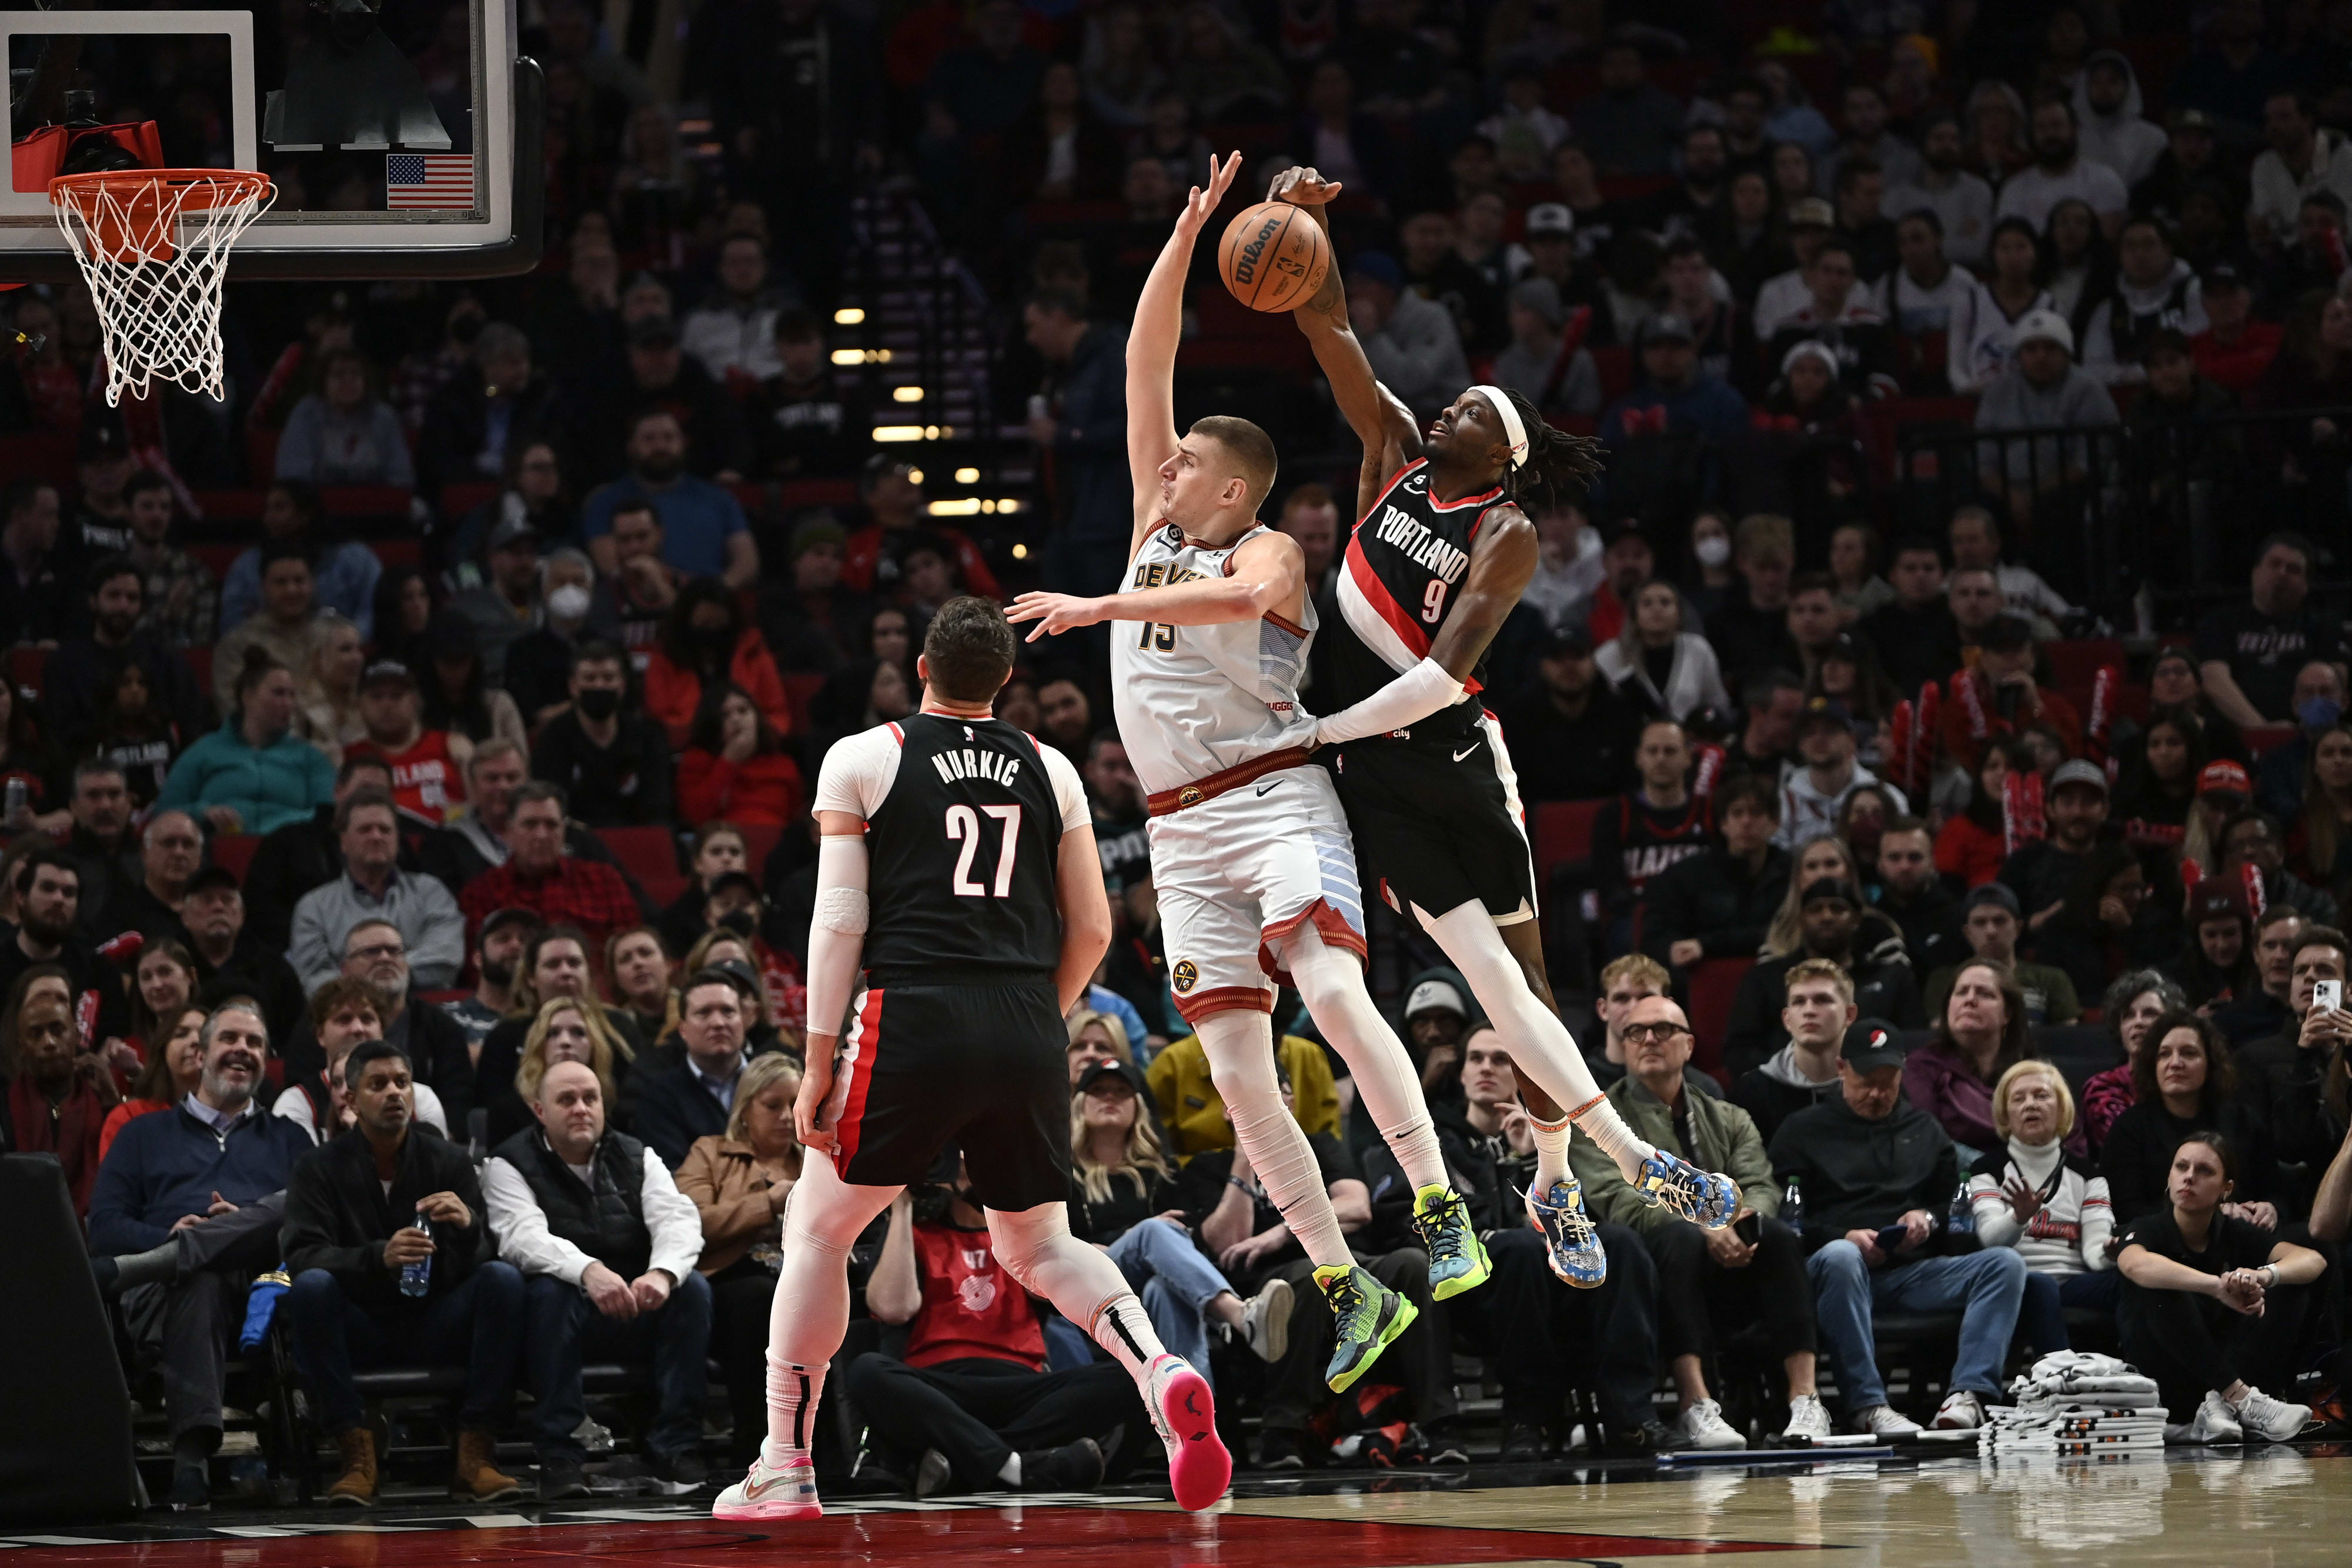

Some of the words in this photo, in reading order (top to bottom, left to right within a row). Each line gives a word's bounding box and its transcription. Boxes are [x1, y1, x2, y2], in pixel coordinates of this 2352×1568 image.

[1236, 219, 1282, 285] Wilson
[1414, 474, 1426, 485] 6
[1170, 528, 1182, 538] 6
[1376, 504, 1469, 585] PORTLAND
[1421, 578, 1448, 624] 9
[931, 748, 1021, 787] NURKIĆ
[945, 803, 1021, 898] 27
